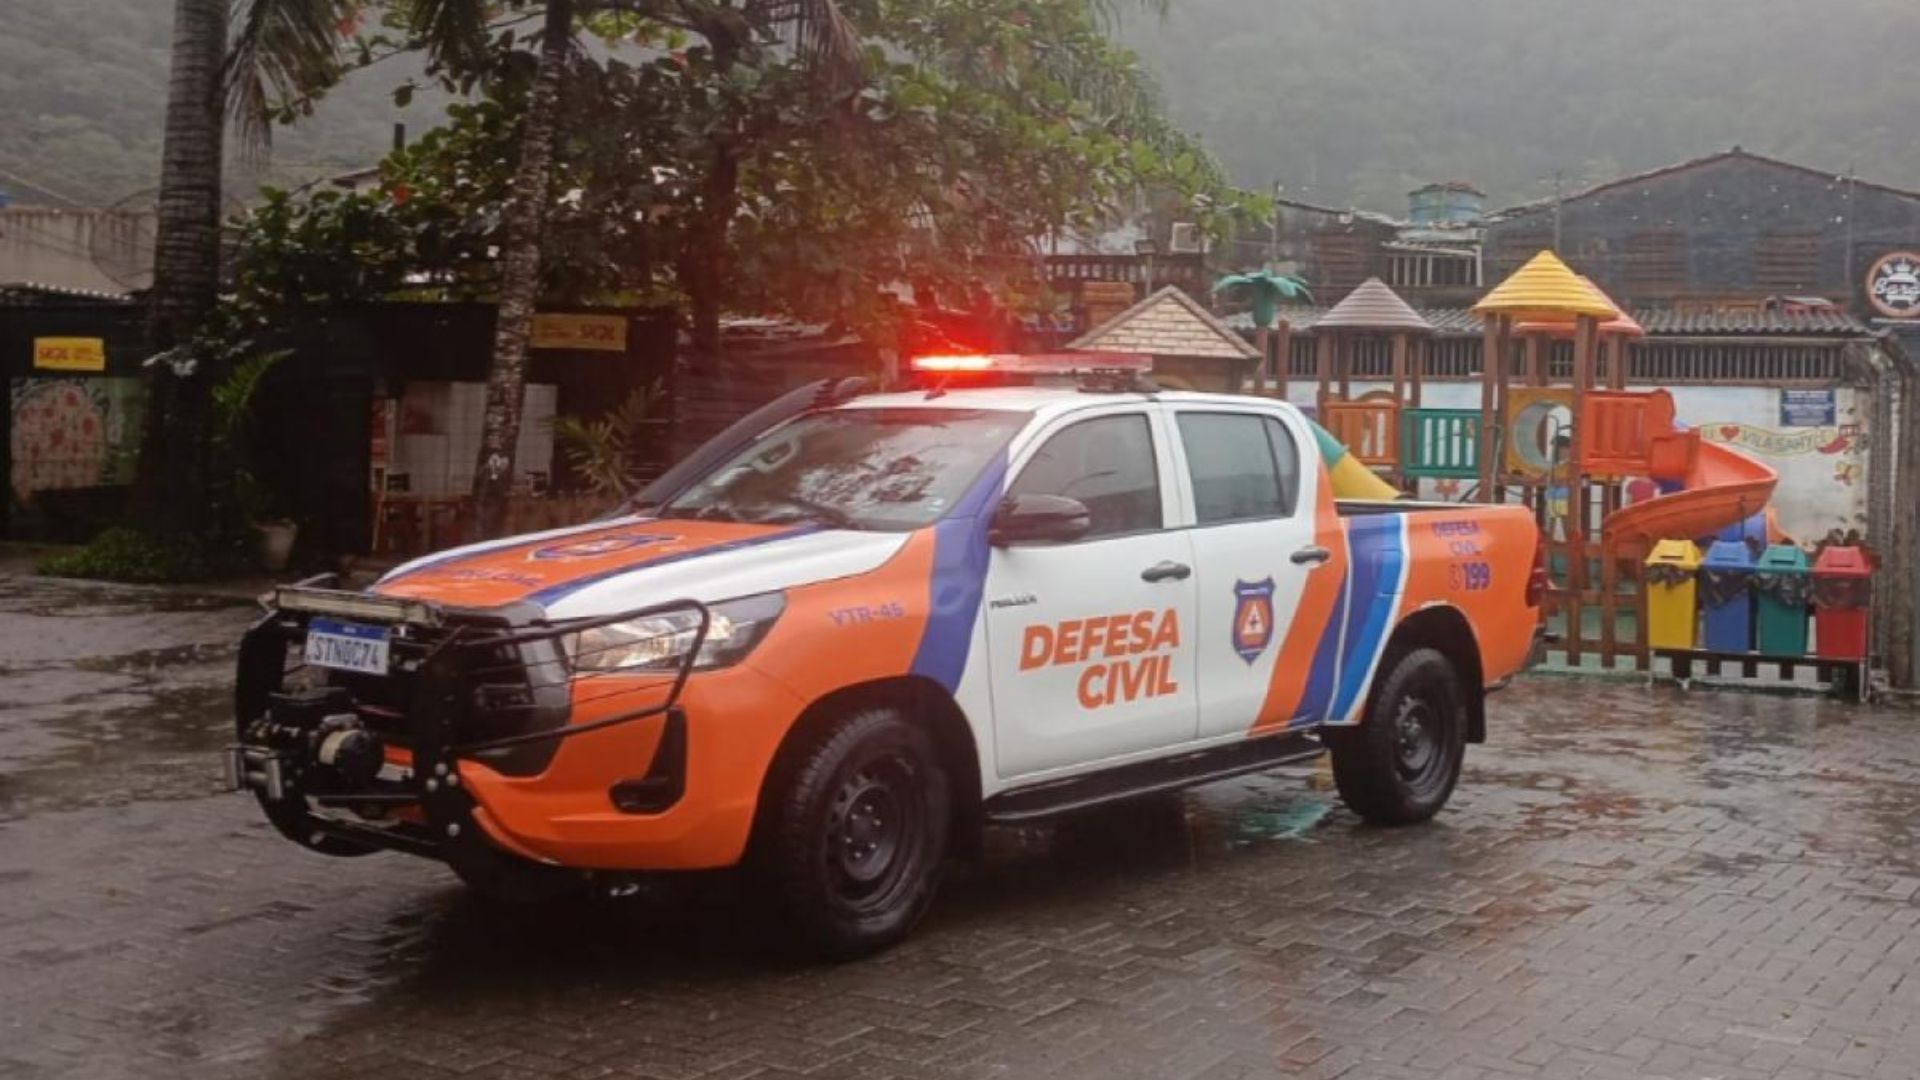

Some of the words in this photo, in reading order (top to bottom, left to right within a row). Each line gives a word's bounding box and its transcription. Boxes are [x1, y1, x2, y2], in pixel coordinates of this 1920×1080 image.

[1461, 562, 1490, 590] 199
[1020, 608, 1179, 671] DEFESA
[1077, 655, 1177, 709] CIVIL
